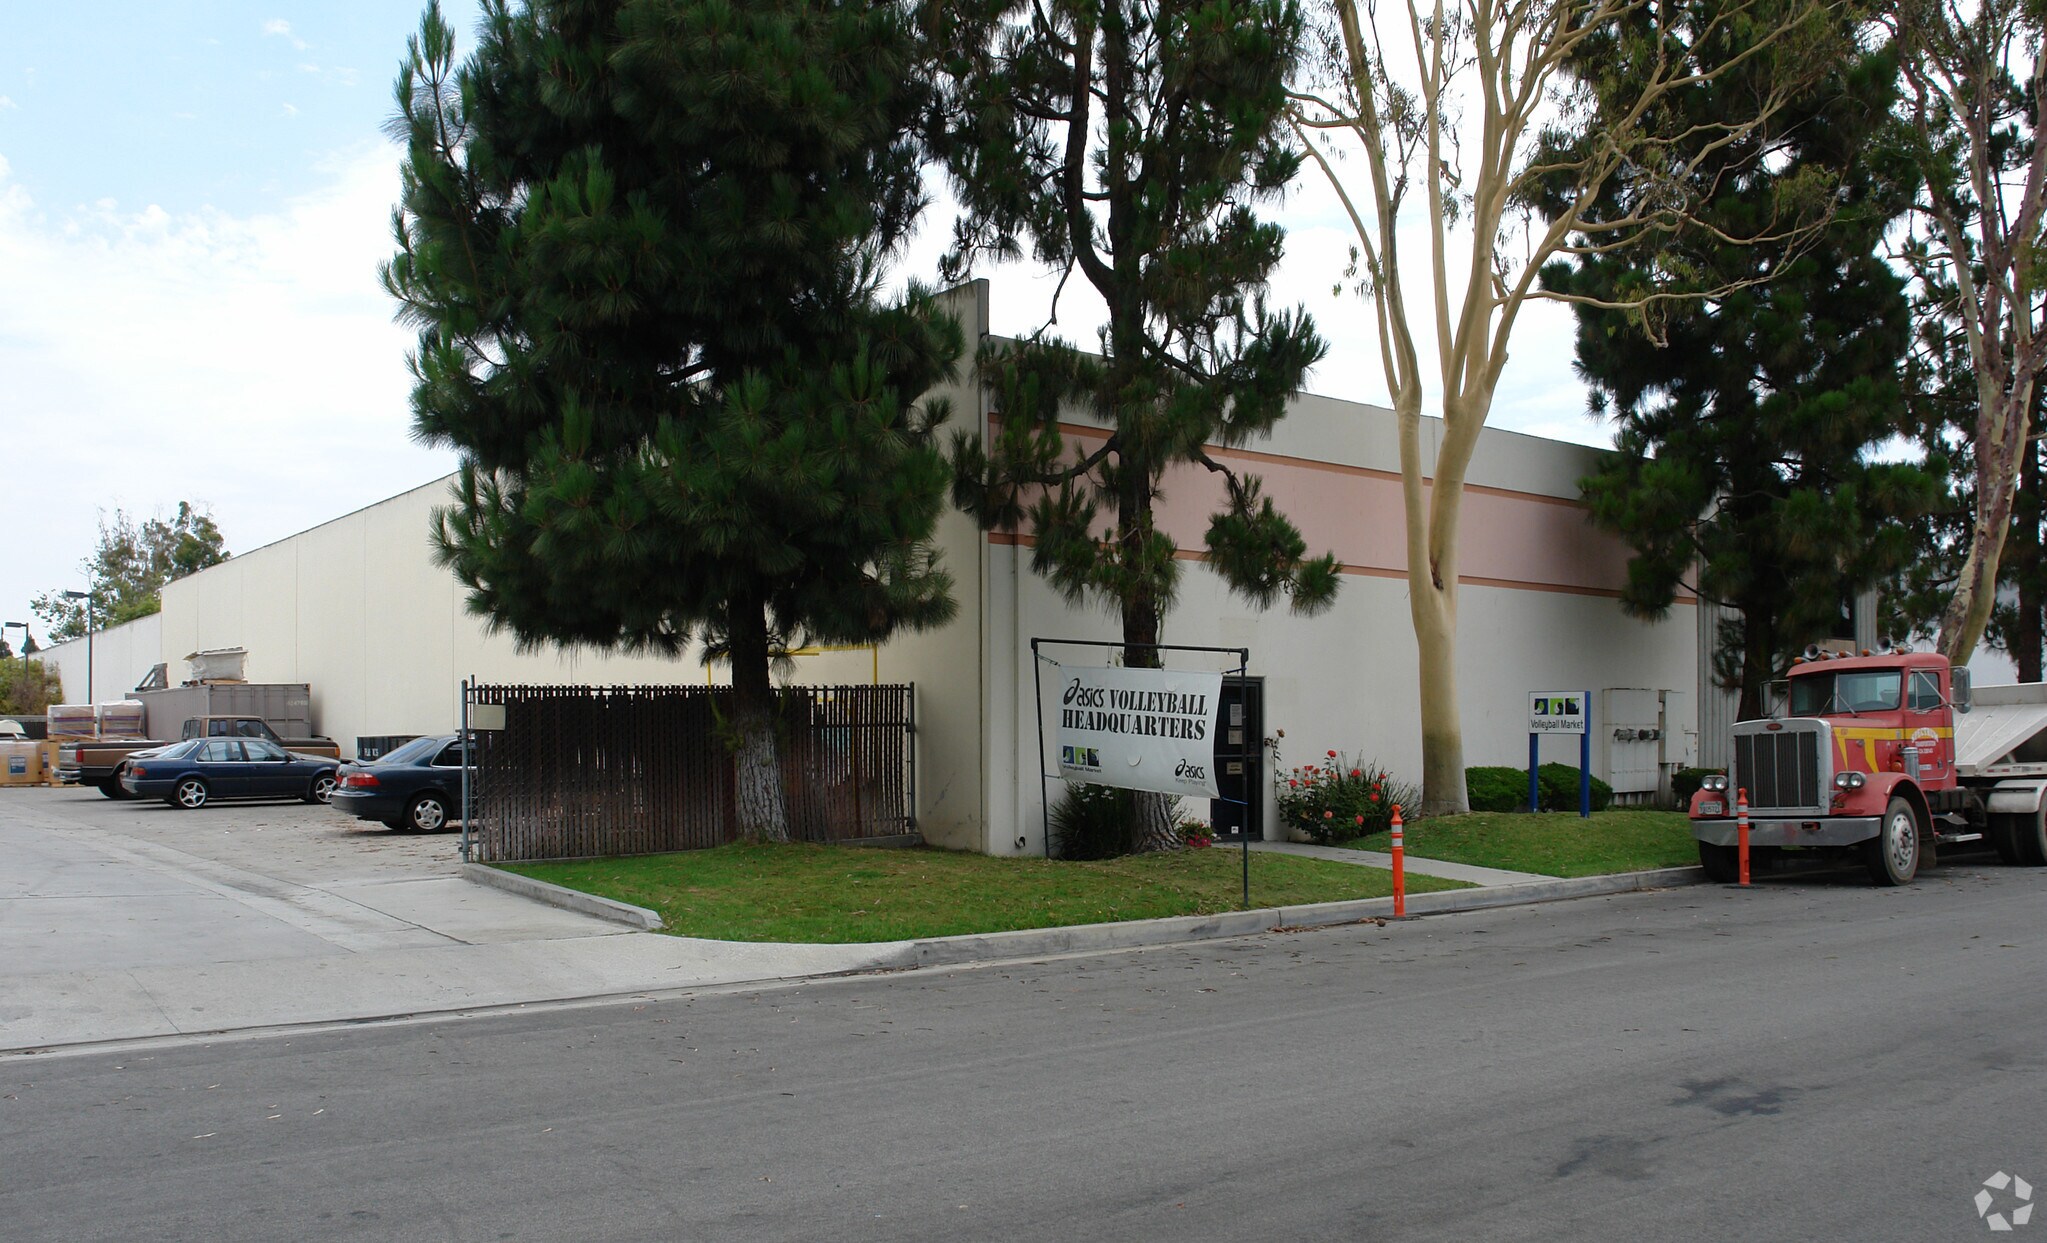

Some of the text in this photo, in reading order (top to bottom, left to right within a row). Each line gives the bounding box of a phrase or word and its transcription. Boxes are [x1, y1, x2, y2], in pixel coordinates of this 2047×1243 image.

[1109, 689, 1208, 716] VOLLEYBALL
[1062, 708, 1206, 740] HEADQUARTERS
[1530, 719, 1584, 731] Volleyball Market
